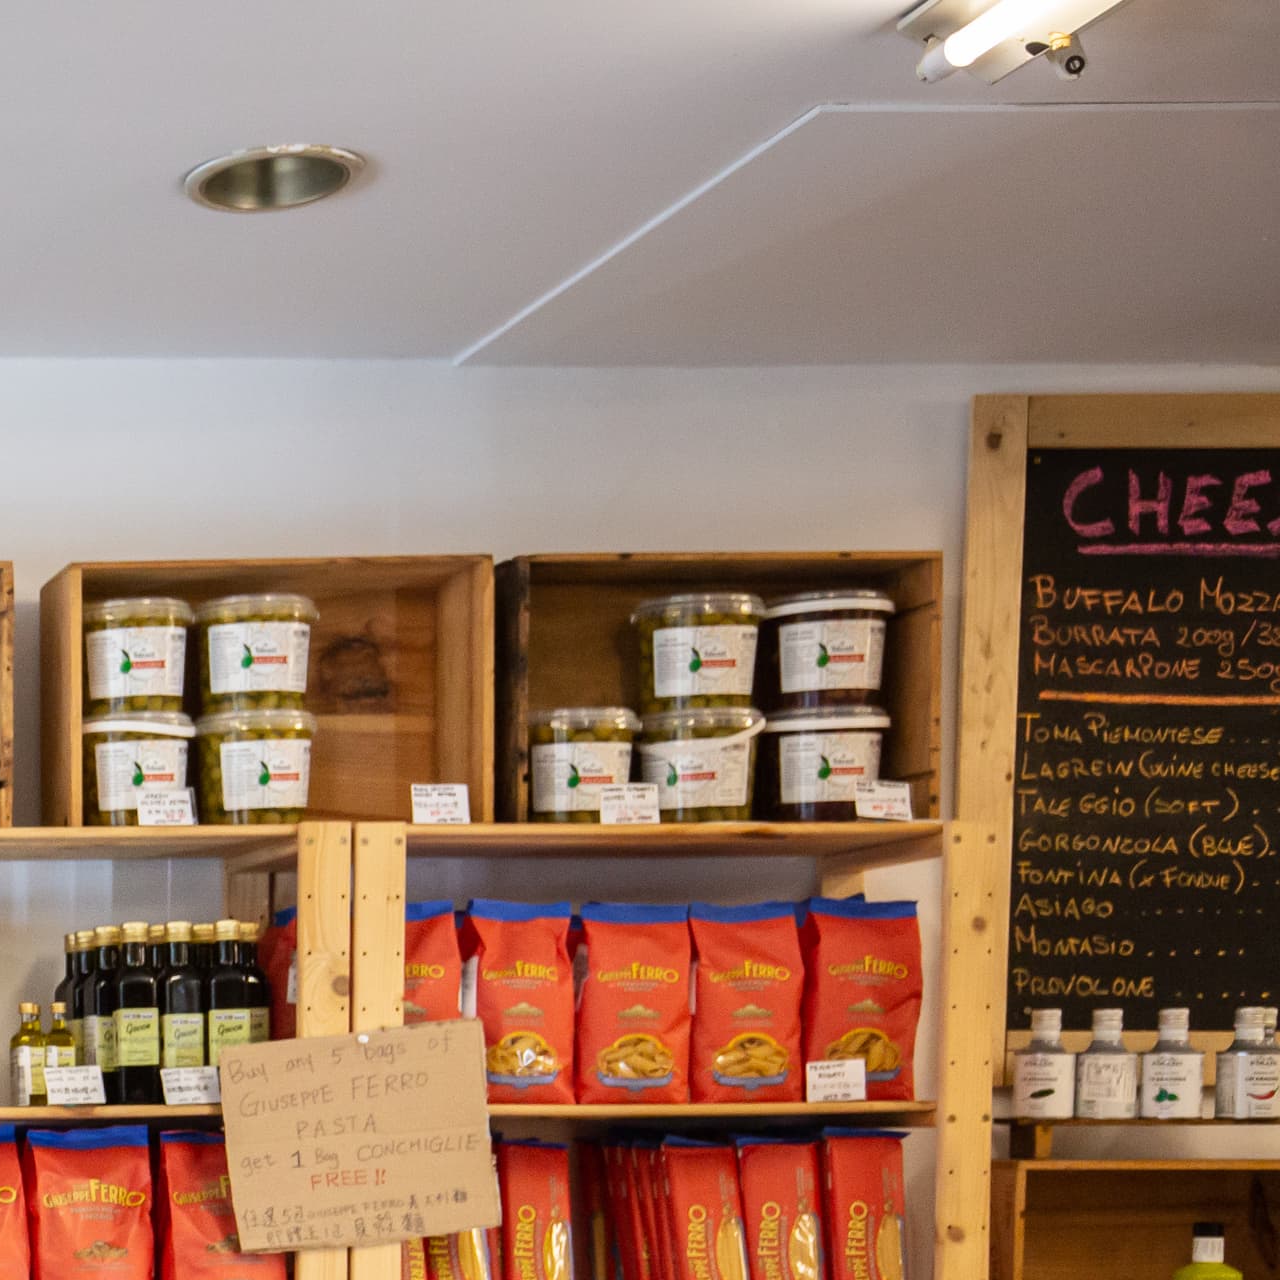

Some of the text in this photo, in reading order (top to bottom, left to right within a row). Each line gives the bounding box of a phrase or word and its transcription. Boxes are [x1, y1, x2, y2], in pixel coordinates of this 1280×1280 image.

[1029, 575, 1183, 614] BUFFALO
[1030, 615, 1160, 647] BURRATA
[1033, 651, 1200, 678] MASCARPONE
[1018, 712, 1224, 744] TOMA PIEMONTESE
[1015, 894, 1113, 920] ASIAGO
[1015, 926, 1134, 956] MONTASIO
[405, 963, 445, 980] ERRO
[515, 960, 558, 982] FERRO
[631, 961, 679, 983] FERRO
[744, 959, 790, 982] FERRO
[863, 955, 908, 980] FERRO
[1013, 968, 1154, 997] PROVOLONE
[229, 1059, 267, 1085] Buy
[287, 1055, 313, 1073] any
[332, 1047, 345, 1063] 5
[361, 1038, 406, 1063] bags
[428, 1031, 451, 1052] of
[241, 1085, 333, 1117] GIUSEPPE
[352, 1071, 429, 1100] FERRO
[297, 1114, 377, 1139] PASTA
[242, 1153, 277, 1177] get
[292, 1151, 304, 1168] 1
[357, 1134, 480, 1162] CONCHIGLIE
[89, 1178, 146, 1208] FERRO
[514, 1205, 536, 1258] FERRO
[686, 1205, 707, 1260] FERRO
[757, 1201, 781, 1257] FERRO
[844, 1200, 868, 1257] FERRO
